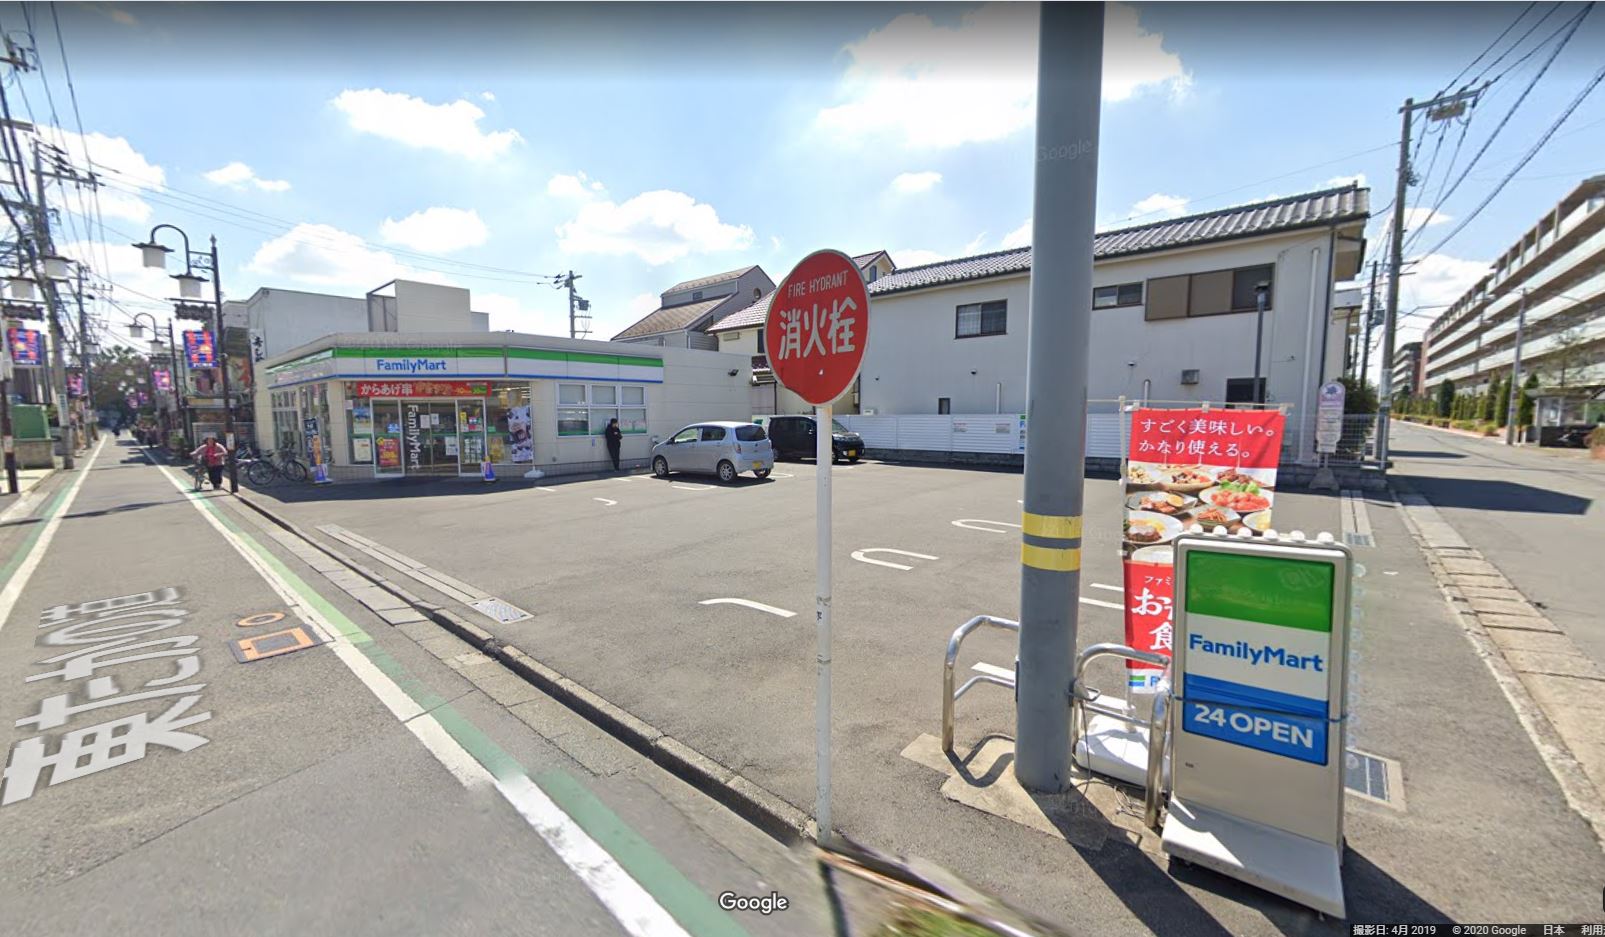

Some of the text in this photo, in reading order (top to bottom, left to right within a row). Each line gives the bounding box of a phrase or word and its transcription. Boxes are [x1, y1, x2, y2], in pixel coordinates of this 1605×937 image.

[788, 270, 849, 298] FIRE HYDRANT
[778, 296, 857, 360] 消火栓
[376, 358, 447, 373] FamilyMart
[406, 404, 422, 470] FamilyMart
[1140, 418, 1275, 437] すごく美味しい。
[1138, 439, 1250, 458] かなり使える。
[1189, 633, 1324, 672] FamilyMart
[1229, 712, 1313, 749] OPEN
